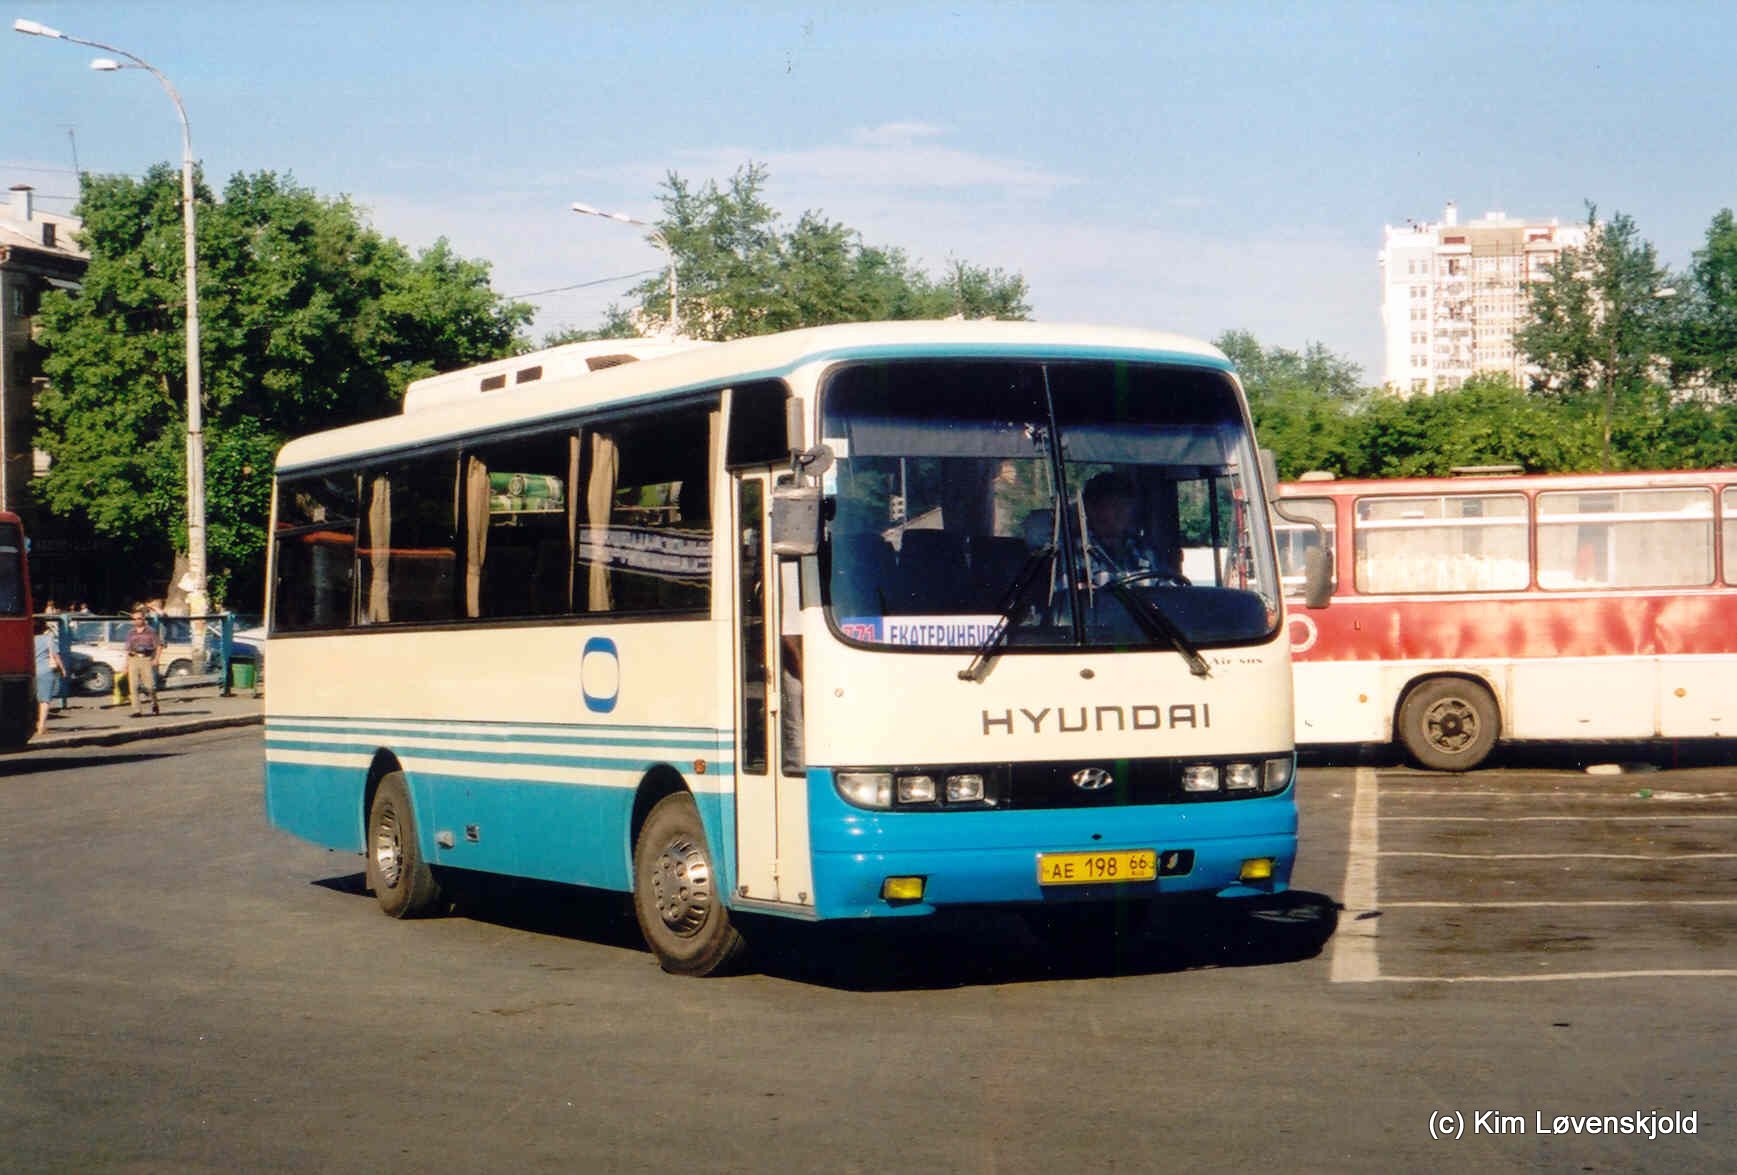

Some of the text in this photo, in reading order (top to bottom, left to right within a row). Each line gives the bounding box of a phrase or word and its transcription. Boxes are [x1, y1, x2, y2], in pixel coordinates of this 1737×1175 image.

[890, 624, 1004, 647] ЕКАТЕРИНБУР
[982, 703, 1210, 735] HYUNDAI
[1085, 857, 1118, 877] 198
[1128, 854, 1147, 870] 66
